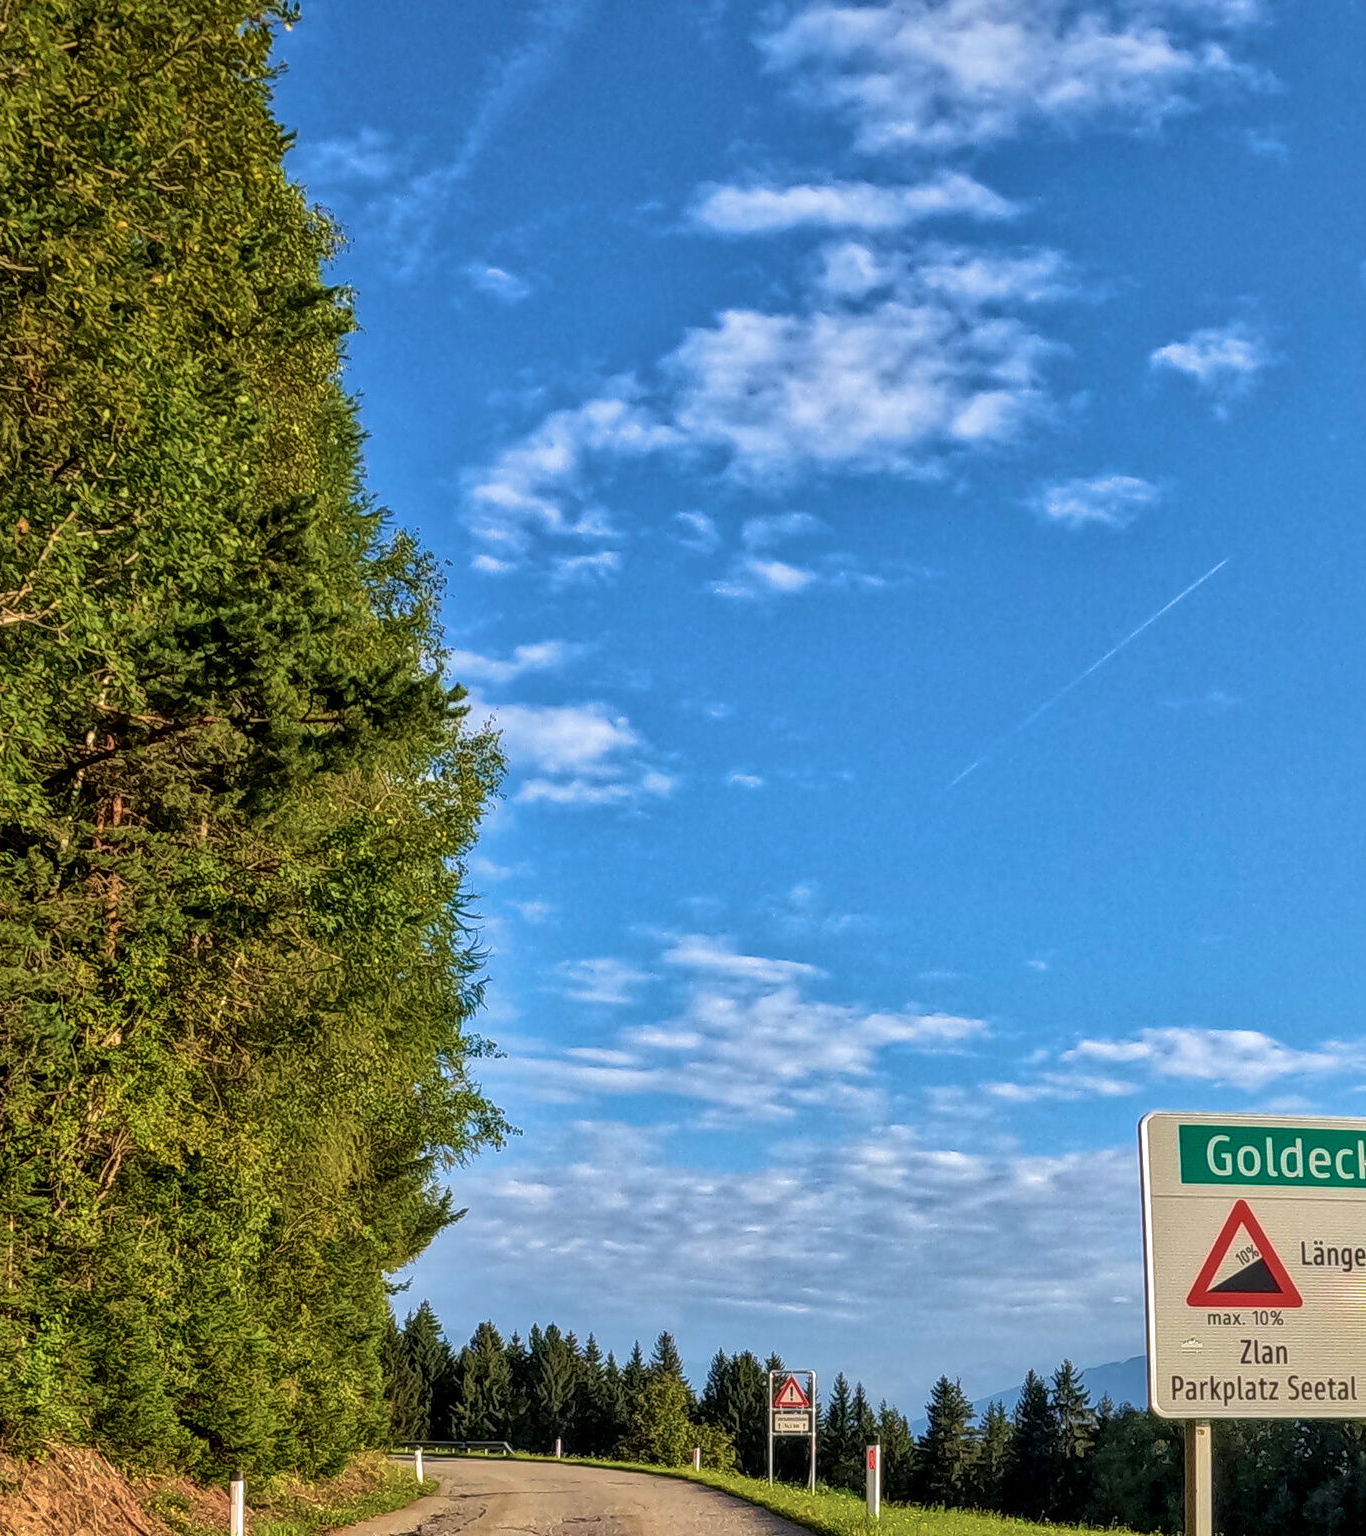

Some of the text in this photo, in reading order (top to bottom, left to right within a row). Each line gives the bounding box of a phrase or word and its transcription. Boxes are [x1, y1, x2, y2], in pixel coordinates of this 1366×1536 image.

[1235, 1243, 1260, 1266] 10%
[1301, 1241, 1366, 1272] Länge
[1207, 1311, 1285, 1327] max. 10%
[1240, 1339, 1288, 1365] Zlan
[1171, 1375, 1279, 1405] Parkplatz
[1287, 1375, 1358, 1401] Seetal
